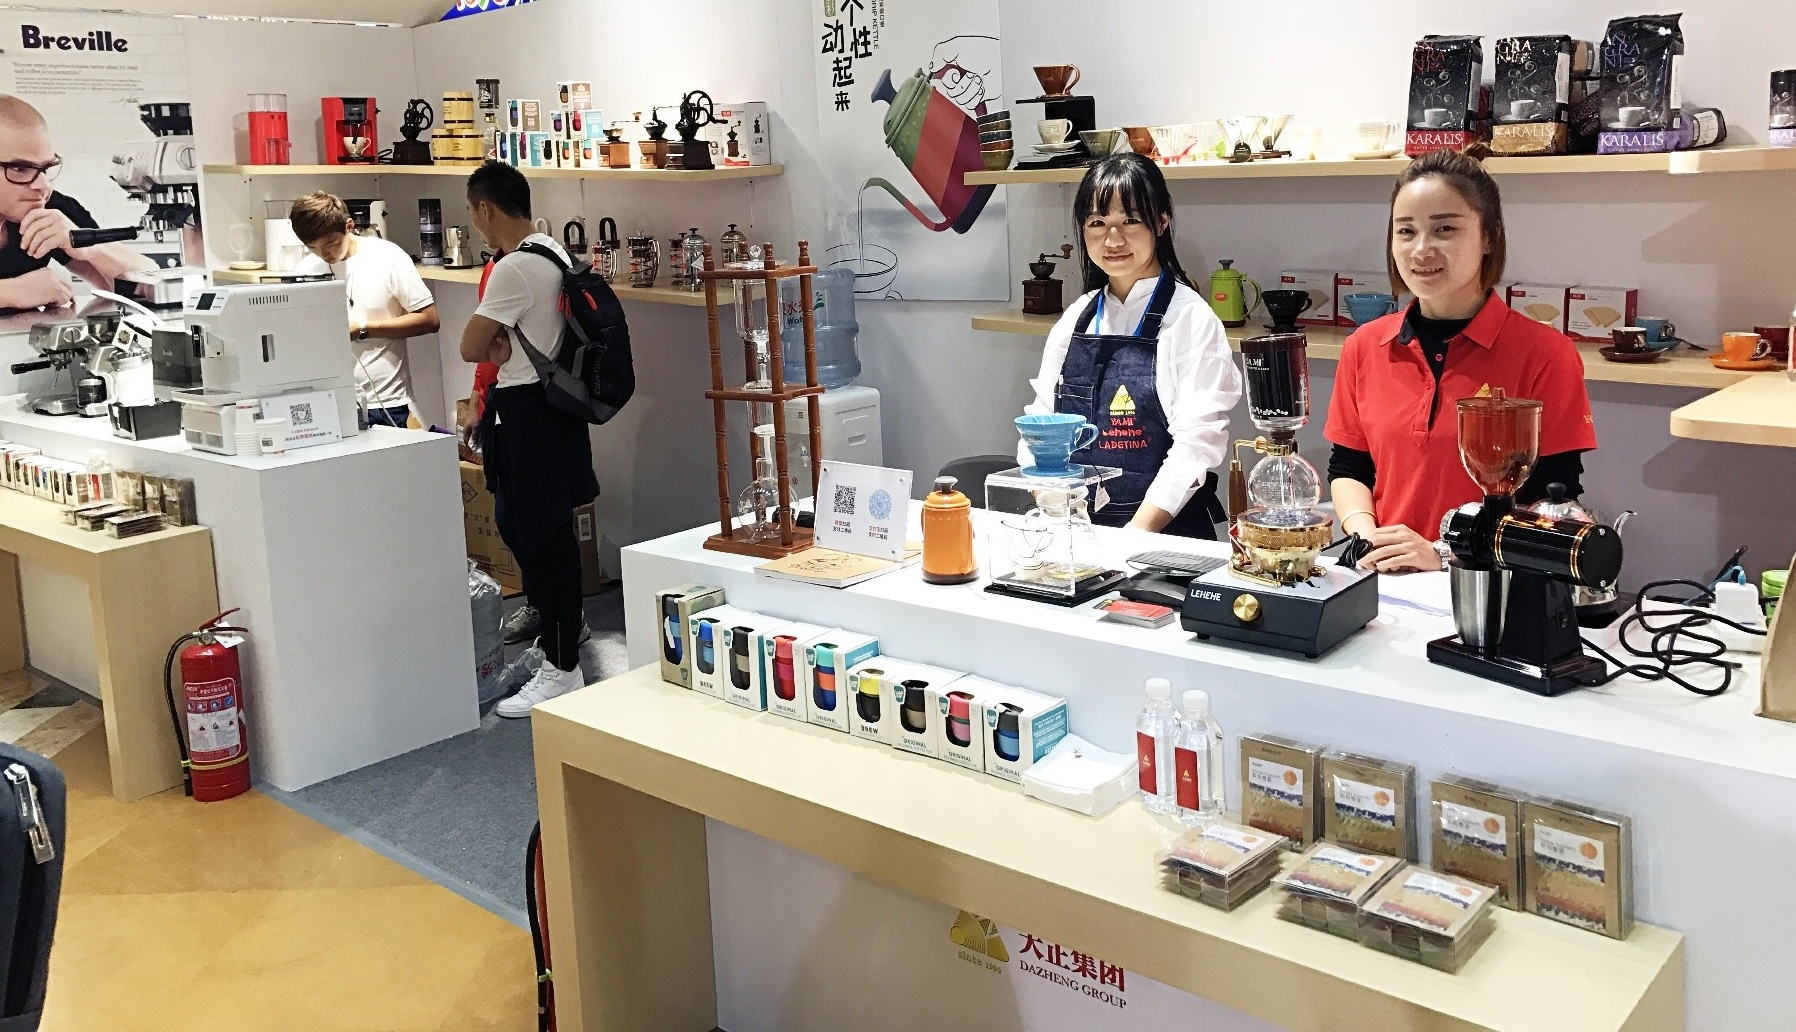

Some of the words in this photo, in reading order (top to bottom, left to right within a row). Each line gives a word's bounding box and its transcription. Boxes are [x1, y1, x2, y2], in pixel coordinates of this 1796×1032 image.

[21, 24, 129, 53] Breville
[822, 19, 855, 111] 动起来
[1495, 126, 1556, 138] KARALIS
[1406, 133, 1461, 145] KARALIS
[1600, 132, 1664, 147] KARALIS
[1098, 440, 1148, 450] LADETINA
[1190, 588, 1222, 601] LEHEHE
[860, 724, 879, 734] BREW
[903, 738, 927, 749] ORIGINAL
[948, 751, 972, 762] ORIGINAL
[995, 765, 1021, 777] ORIGINAL
[957, 950, 982, 966] since
[1019, 959, 1079, 991] DAZHENG
[1082, 984, 1127, 1009] GROUP
